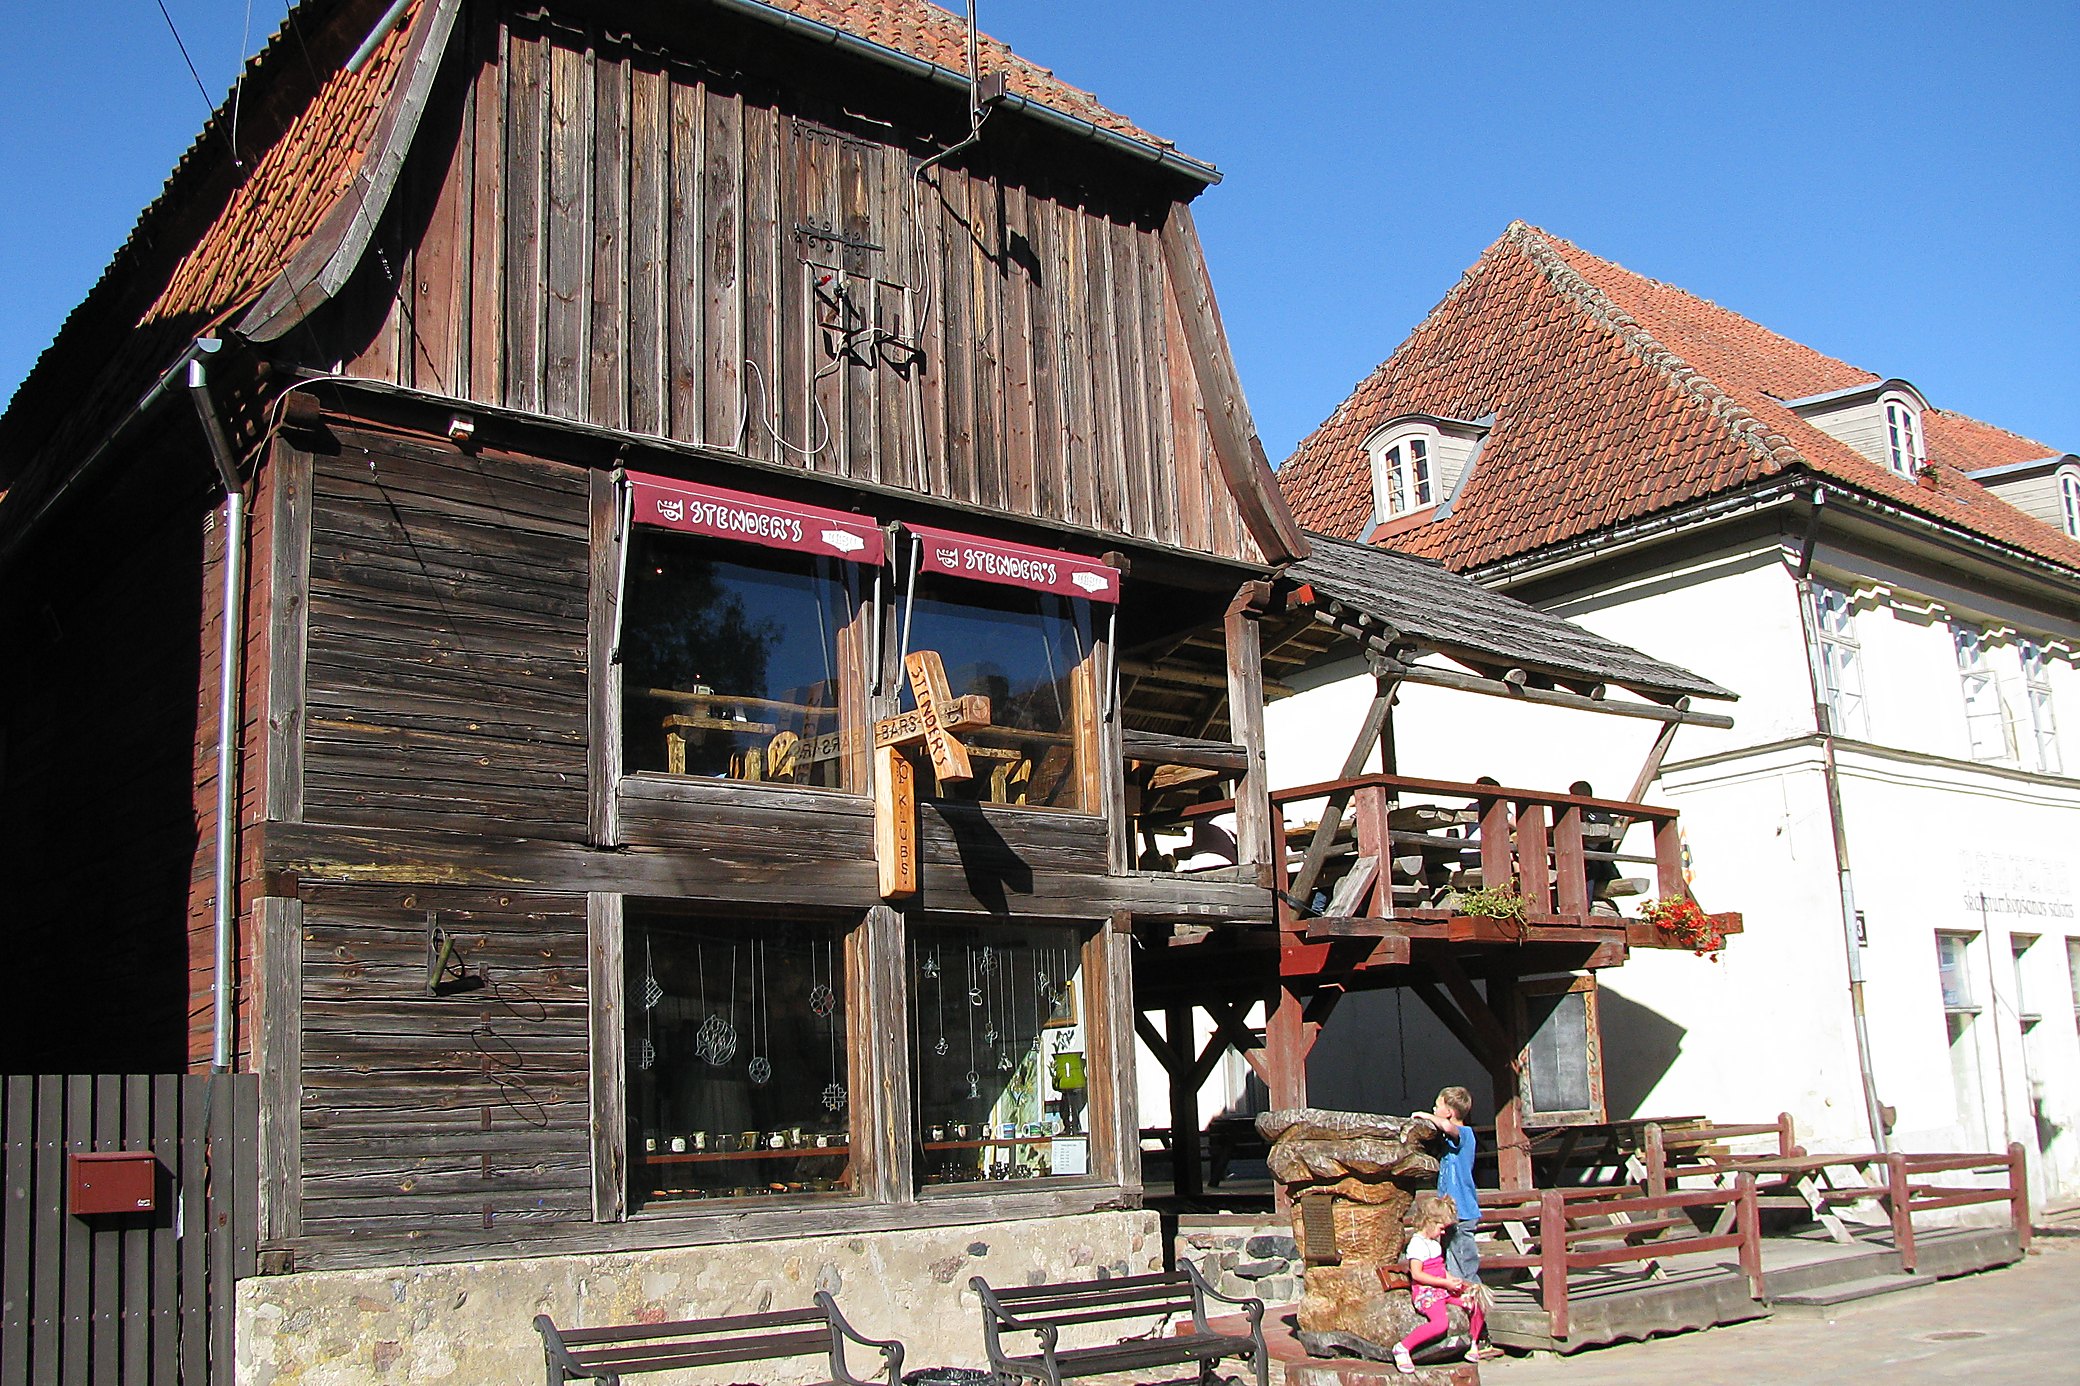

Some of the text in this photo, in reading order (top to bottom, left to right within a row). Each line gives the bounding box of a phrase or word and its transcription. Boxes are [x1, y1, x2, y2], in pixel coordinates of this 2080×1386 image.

[690, 500, 803, 543] STENDER'S
[964, 548, 1057, 585] STENDER'S
[911, 666, 947, 767] STENDER'S
